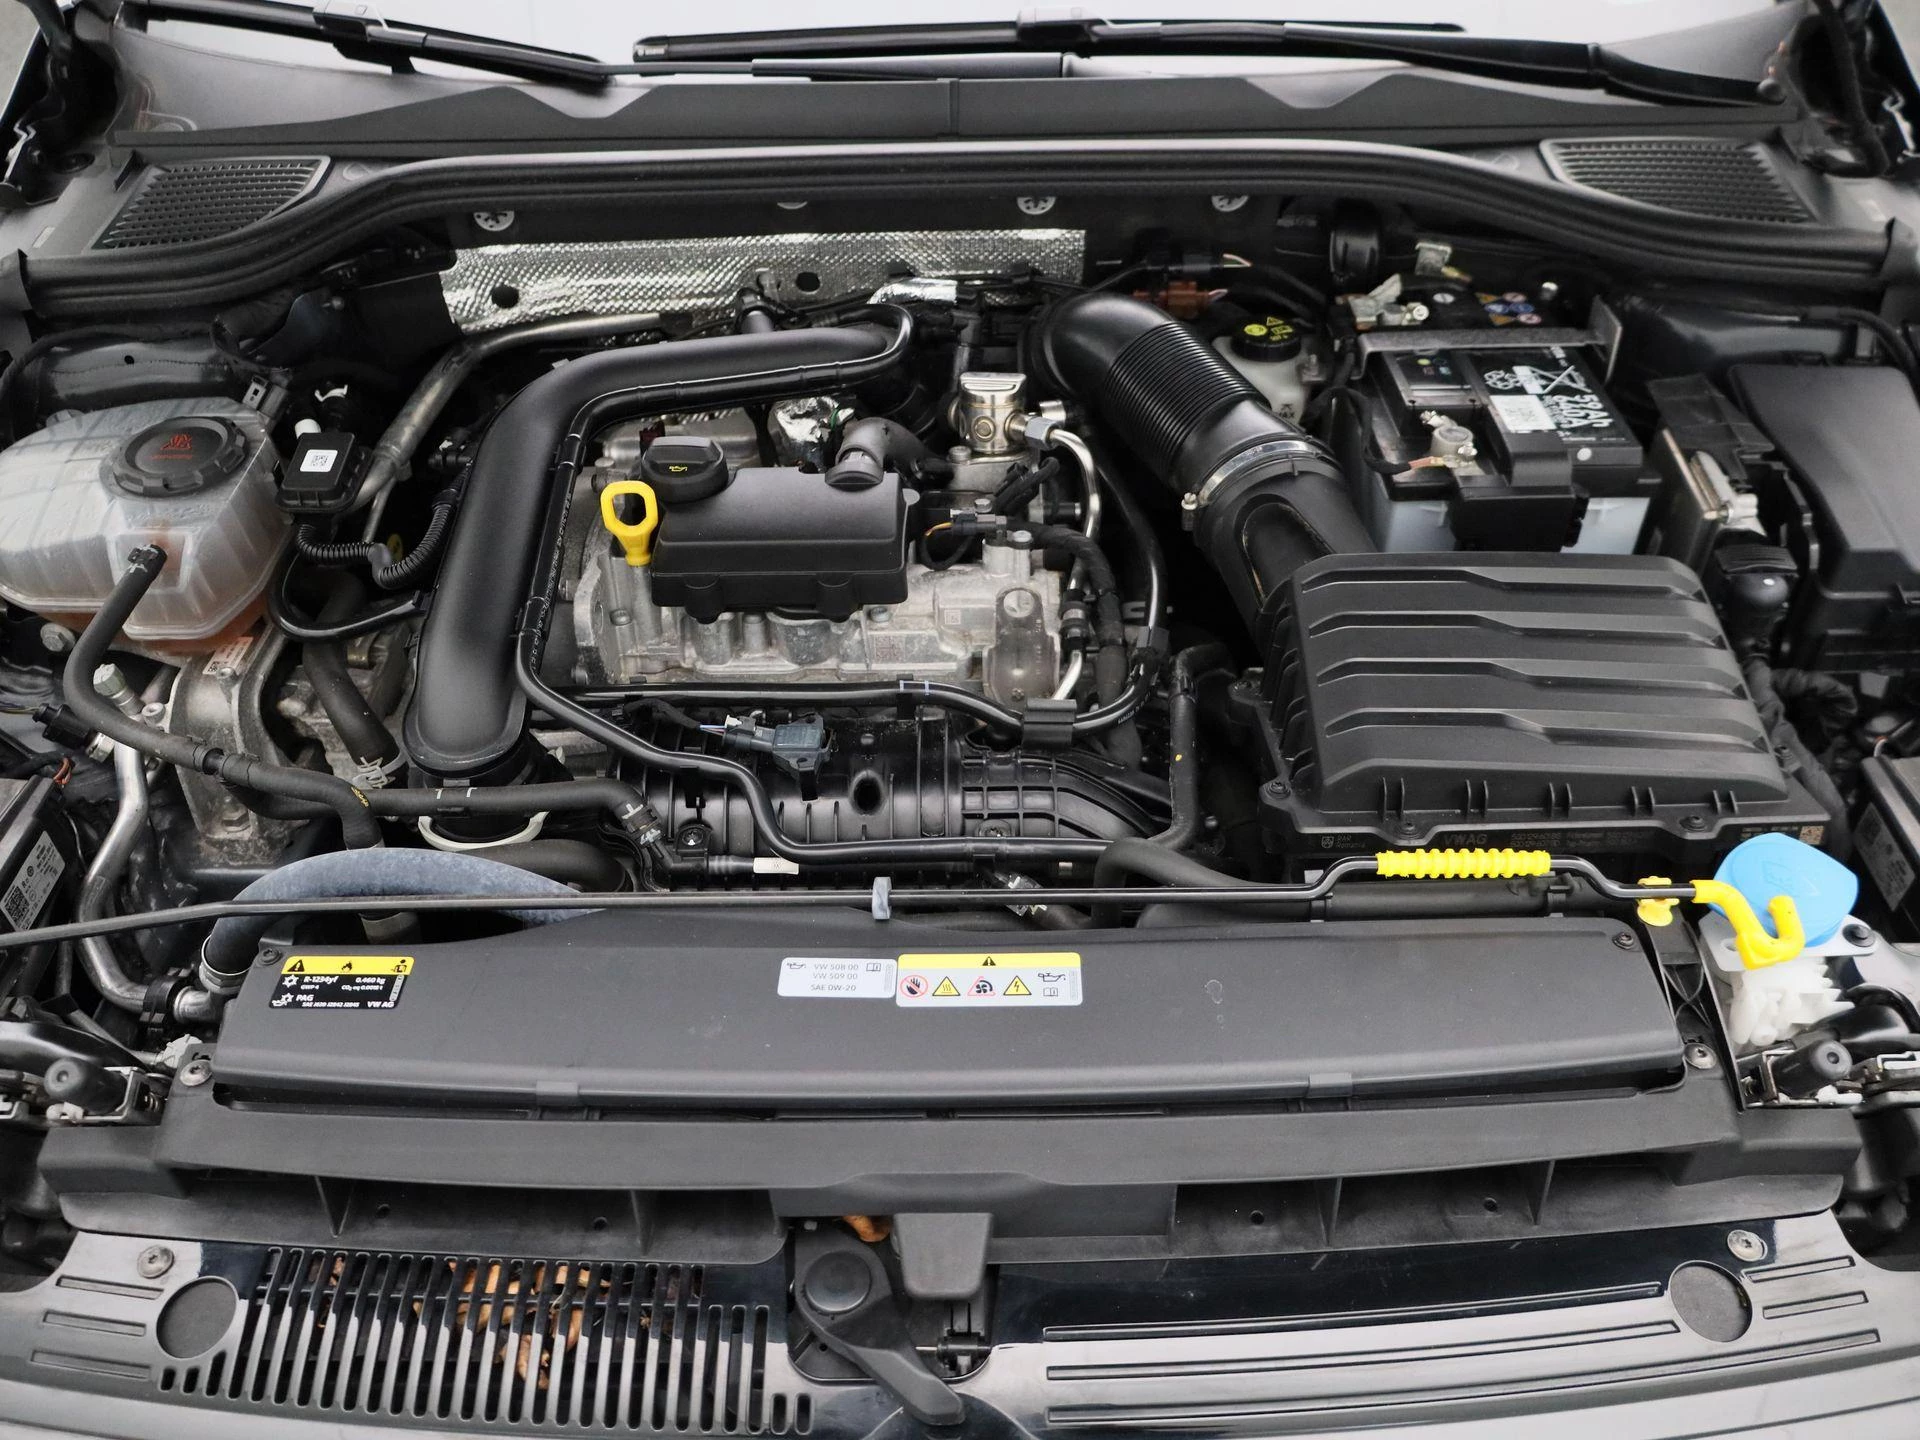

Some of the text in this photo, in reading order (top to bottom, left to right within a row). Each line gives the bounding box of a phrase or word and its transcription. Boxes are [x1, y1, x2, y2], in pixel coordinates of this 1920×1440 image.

[814, 963, 859, 971] VW 508 00
[303, 976, 339, 985] R-1234yf
[376, 977, 386, 985] kg
[827, 984, 857, 992] 0W-20
[295, 994, 314, 1002] PAG
